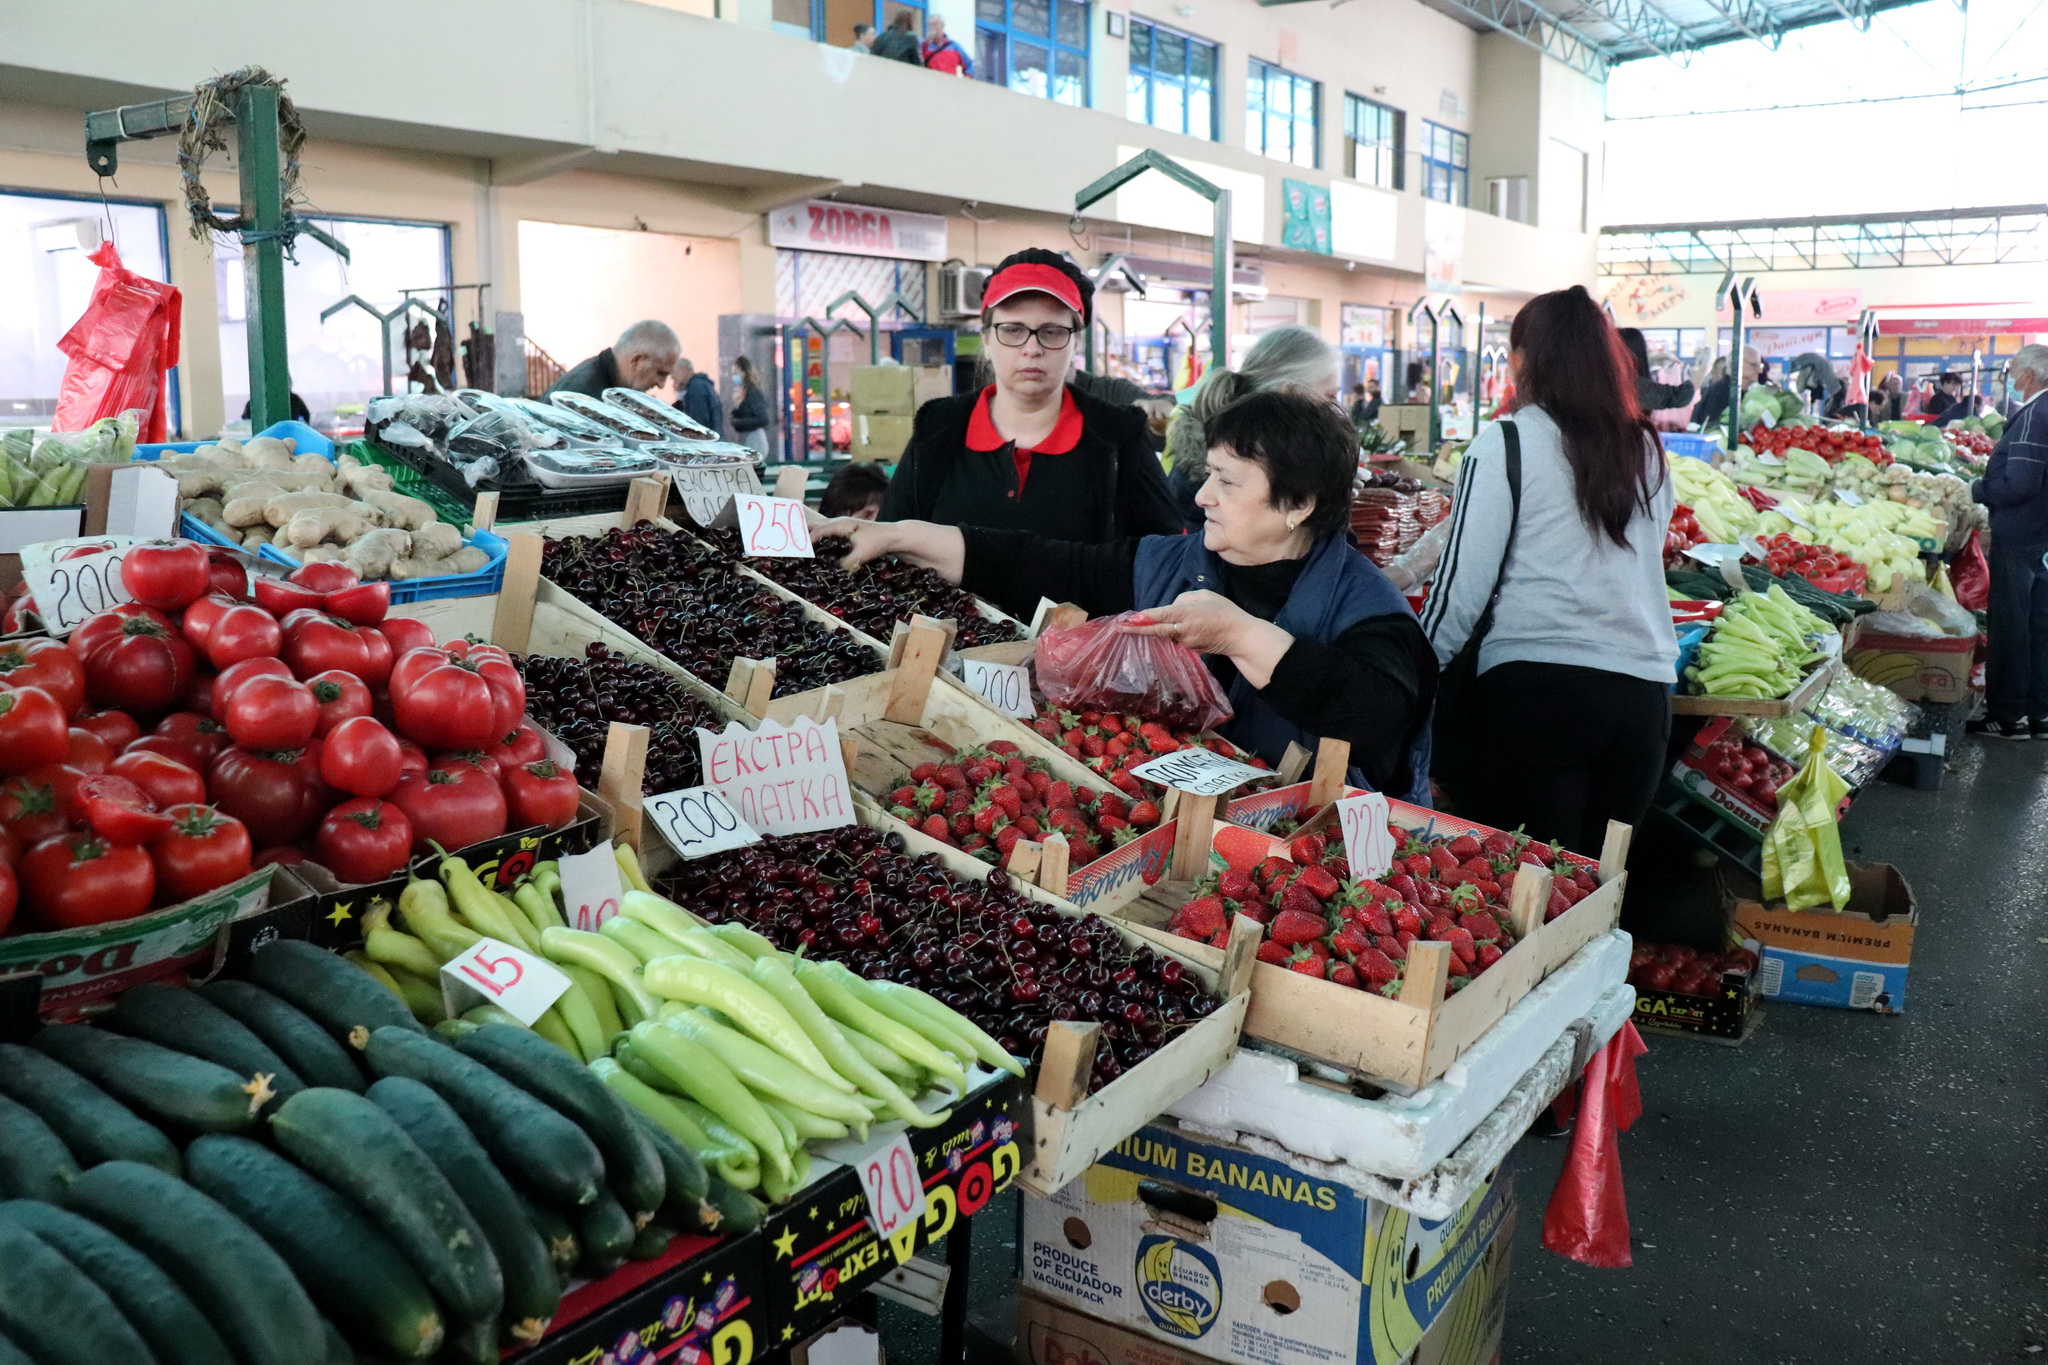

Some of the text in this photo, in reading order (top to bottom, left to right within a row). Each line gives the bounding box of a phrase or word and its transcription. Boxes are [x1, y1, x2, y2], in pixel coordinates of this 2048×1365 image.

[807, 206, 894, 249] ZORGA
[677, 468, 754, 495] ЕКСТРА
[747, 501, 808, 552] 250
[710, 726, 828, 785] ЕКСТРА
[654, 790, 737, 846] 200
[721, 774, 844, 826] ЛАТКА
[1347, 802, 1387, 877] 220
[1755, 921, 1891, 949] PREMIUM BANANAS
[459, 945, 524, 996] 15
[868, 1146, 915, 1232] 20
[1187, 1153, 1338, 1211] BANANAS
[1440, 1198, 1471, 1244] QUALITY
[1033, 1241, 1099, 1277] PRODUCE
[1033, 1255, 1123, 1308] OF ECUADOR
[1173, 1265, 1210, 1281] ECUADOR
[1173, 1271, 1209, 1287] BANANAS
[1426, 1230, 1478, 1313] PREMIUM
[1032, 1270, 1104, 1305] VACUUM PACK
[1148, 1281, 1207, 1321] derby
[1159, 1322, 1187, 1336] QUALITY
